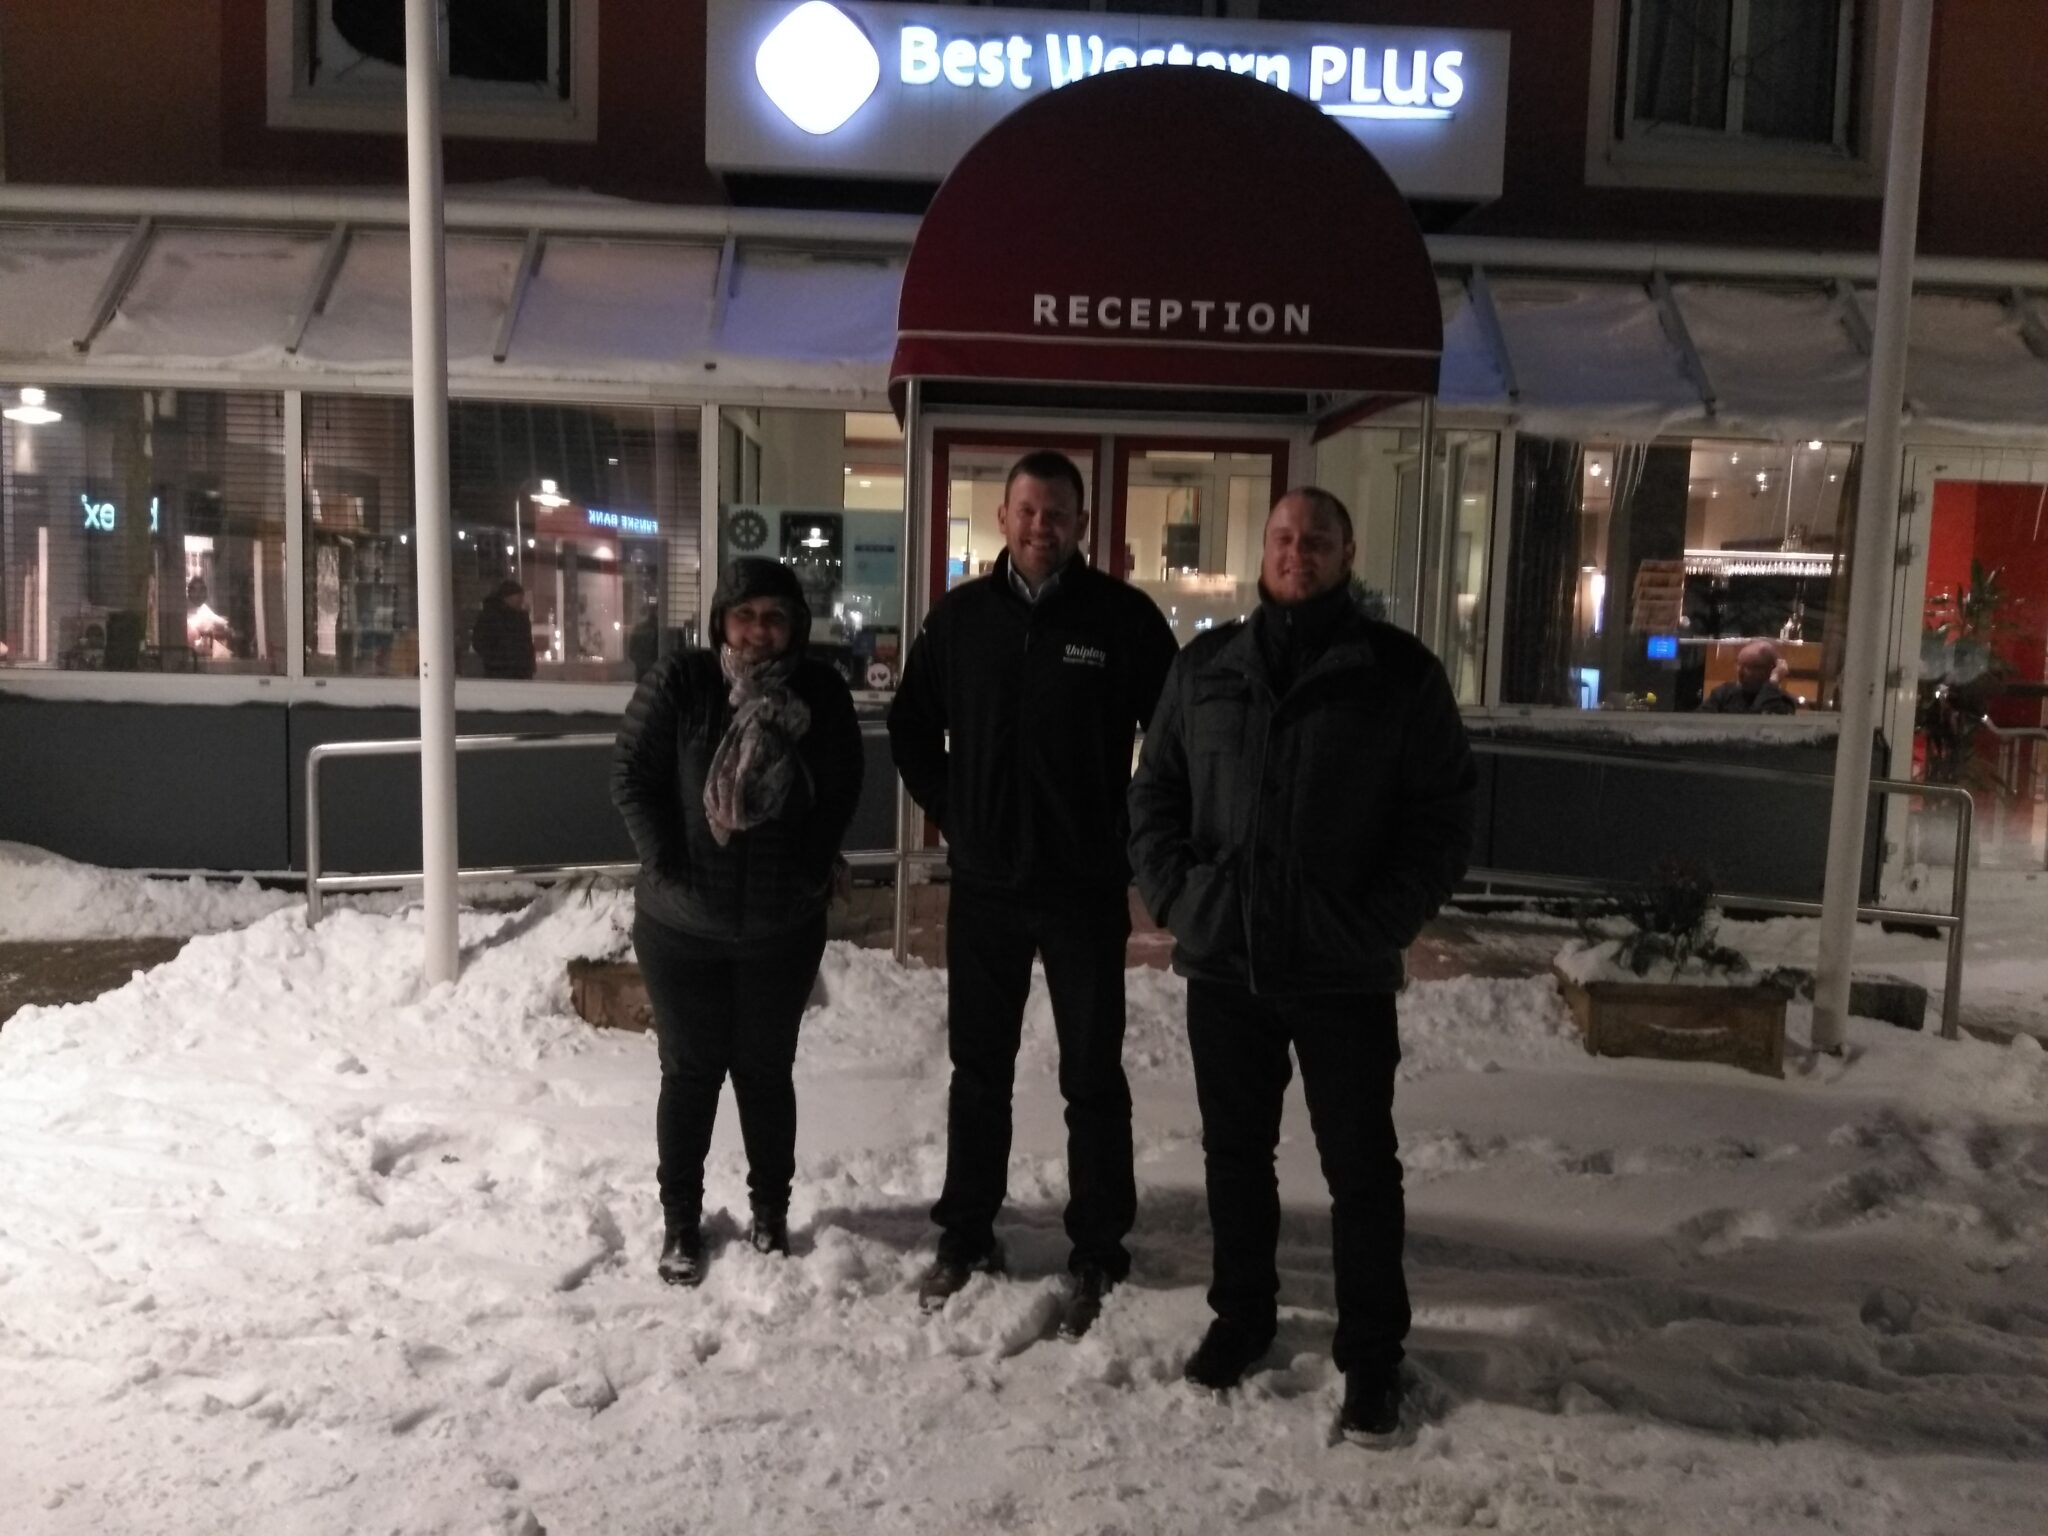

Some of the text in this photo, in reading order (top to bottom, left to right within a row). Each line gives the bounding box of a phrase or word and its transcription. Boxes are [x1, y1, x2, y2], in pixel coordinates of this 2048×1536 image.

[901, 26, 1033, 89] Best
[1309, 45, 1464, 107] PLUS
[1033, 293, 1310, 334] RECEPTION
